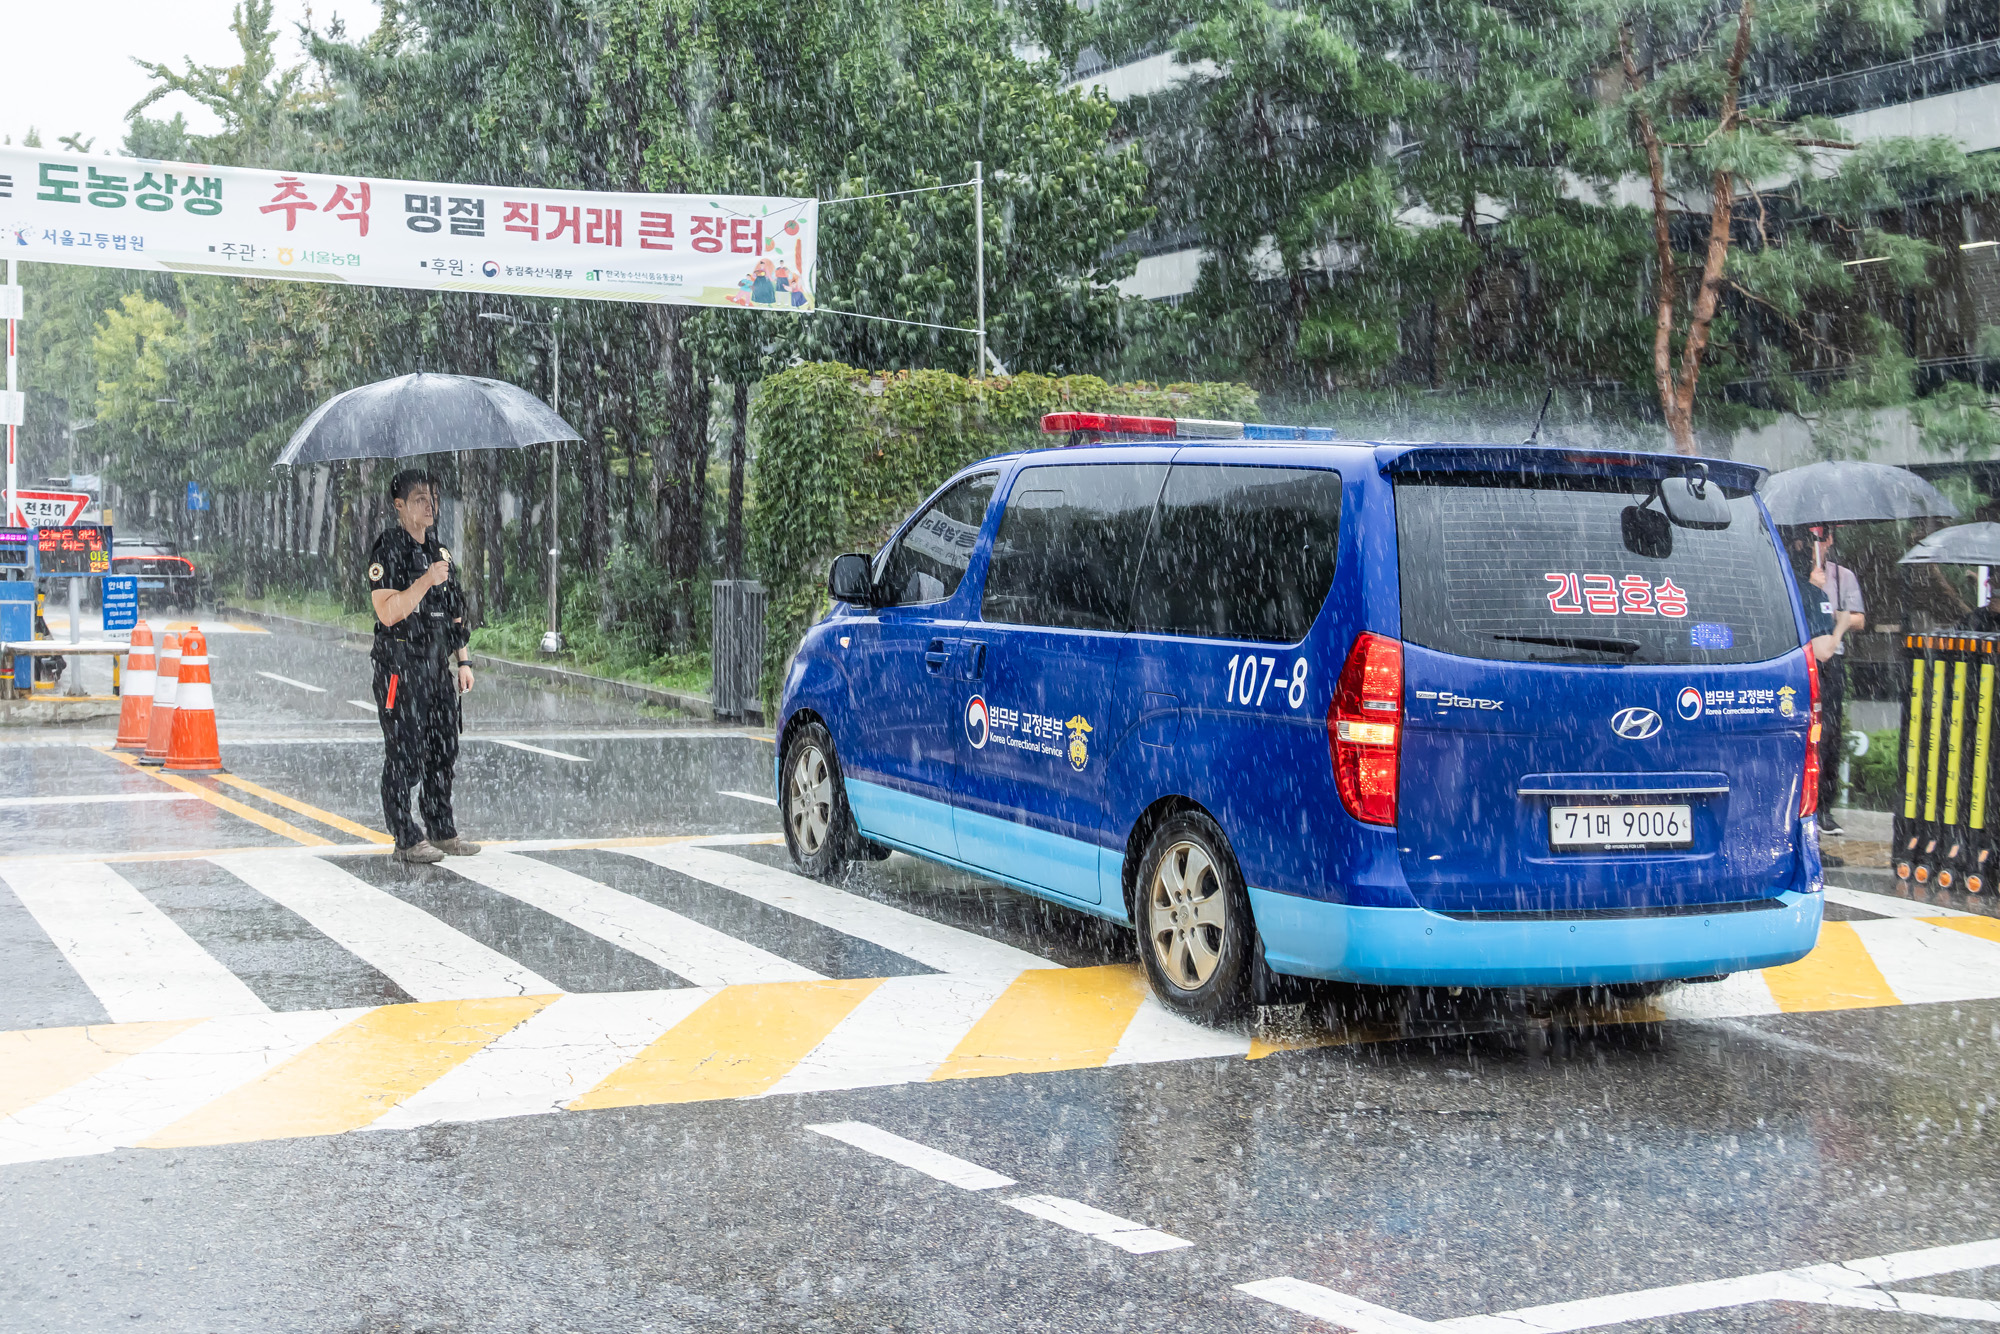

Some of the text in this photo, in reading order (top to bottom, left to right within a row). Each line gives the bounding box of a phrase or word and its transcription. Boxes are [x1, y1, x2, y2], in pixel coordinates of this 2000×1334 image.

[37, 162, 223, 216] 도농상생
[259, 176, 371, 237] 추석
[404, 193, 486, 237] 명절
[503, 201, 622, 248] 직거래
[638, 211, 675, 251] 큰
[690, 215, 763, 256] 장터
[42, 228, 144, 252] 서울고등법원
[300, 250, 361, 267] 서울농협
[505, 264, 573, 280] 농림축산식품부
[25, 502, 65, 517] 천천히
[31, 518, 60, 526] SLOW
[1544, 572, 1688, 618] 긴급호송
[1227, 654, 1308, 709] 107-8
[1437, 692, 1504, 711] Starex
[1705, 689, 1774, 705] 법무부 교정본부
[989, 705, 1063, 740] 법무부 교정본부
[989, 731, 1005, 745] Korea
[1006, 735, 1040, 752] Correctional
[1041, 743, 1063, 758] Service
[1565, 812, 1679, 838] 71머 9006
